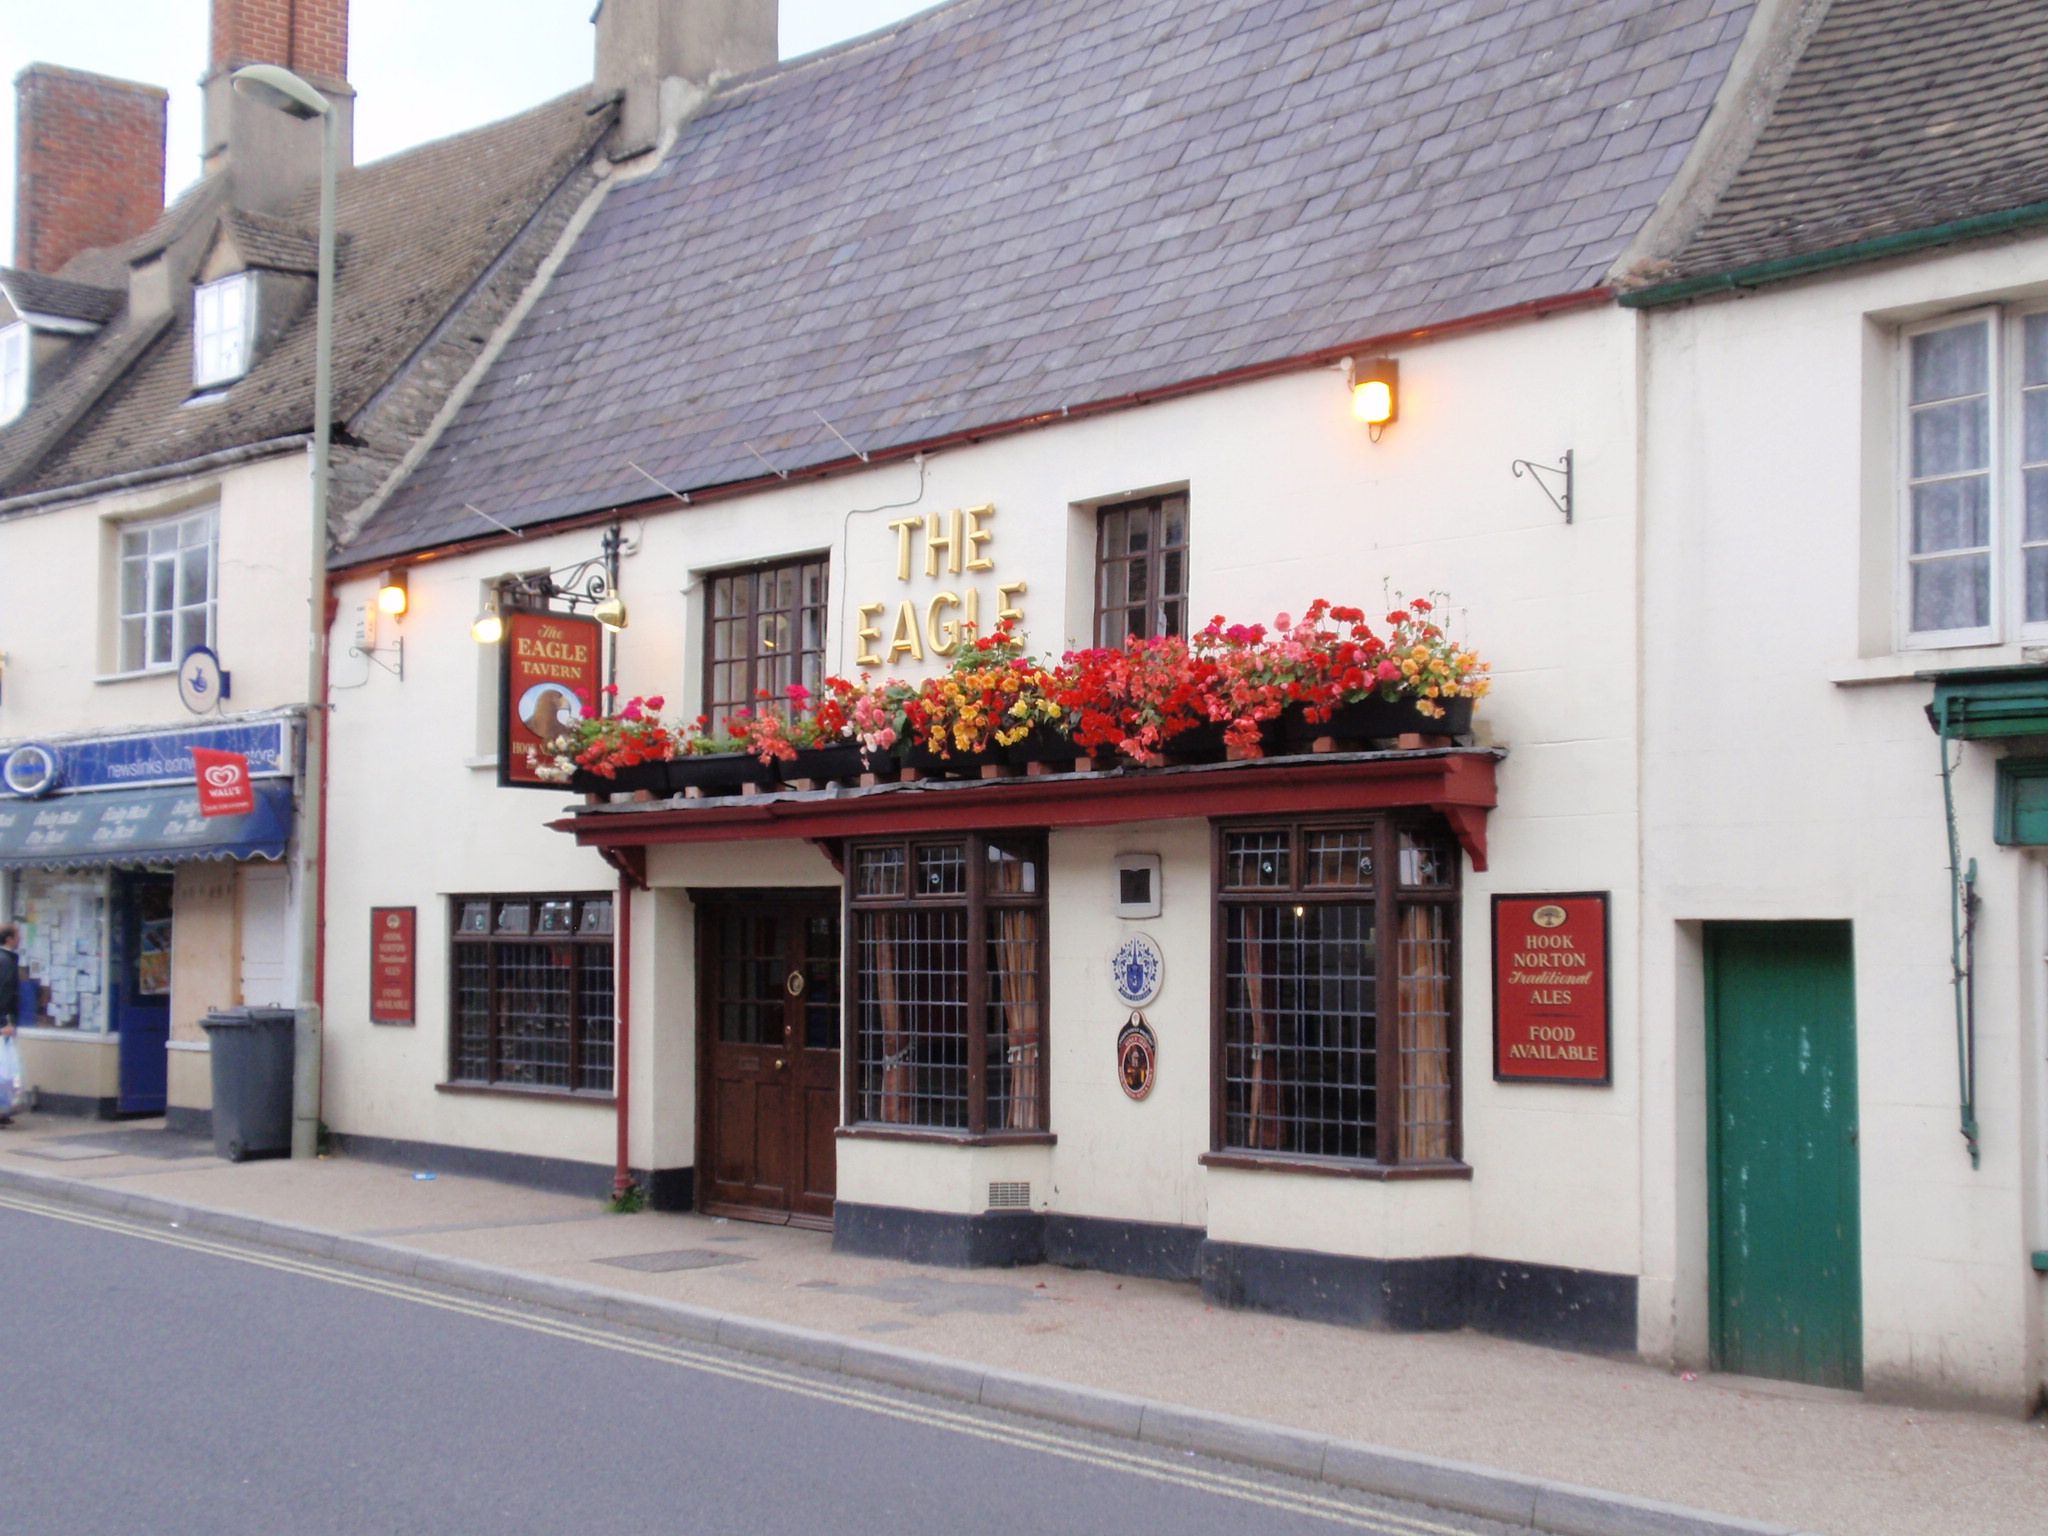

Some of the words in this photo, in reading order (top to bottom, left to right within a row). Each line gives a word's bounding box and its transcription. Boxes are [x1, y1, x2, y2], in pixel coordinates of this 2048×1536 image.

[888, 502, 995, 581] THE
[856, 581, 1028, 666] EAGLE
[537, 624, 564, 640] The
[517, 637, 588, 663] EAGLE
[521, 661, 581, 678] TAVERN
[208, 786, 242, 798] WALL'S
[1526, 935, 1575, 949] HOOK
[1513, 953, 1586, 967] NORTON
[1508, 971, 1593, 985] Traditional
[1530, 990, 1572, 1005] ALES
[1529, 1025, 1576, 1041] FOOD
[1509, 1044, 1599, 1061] AVAILABLE
